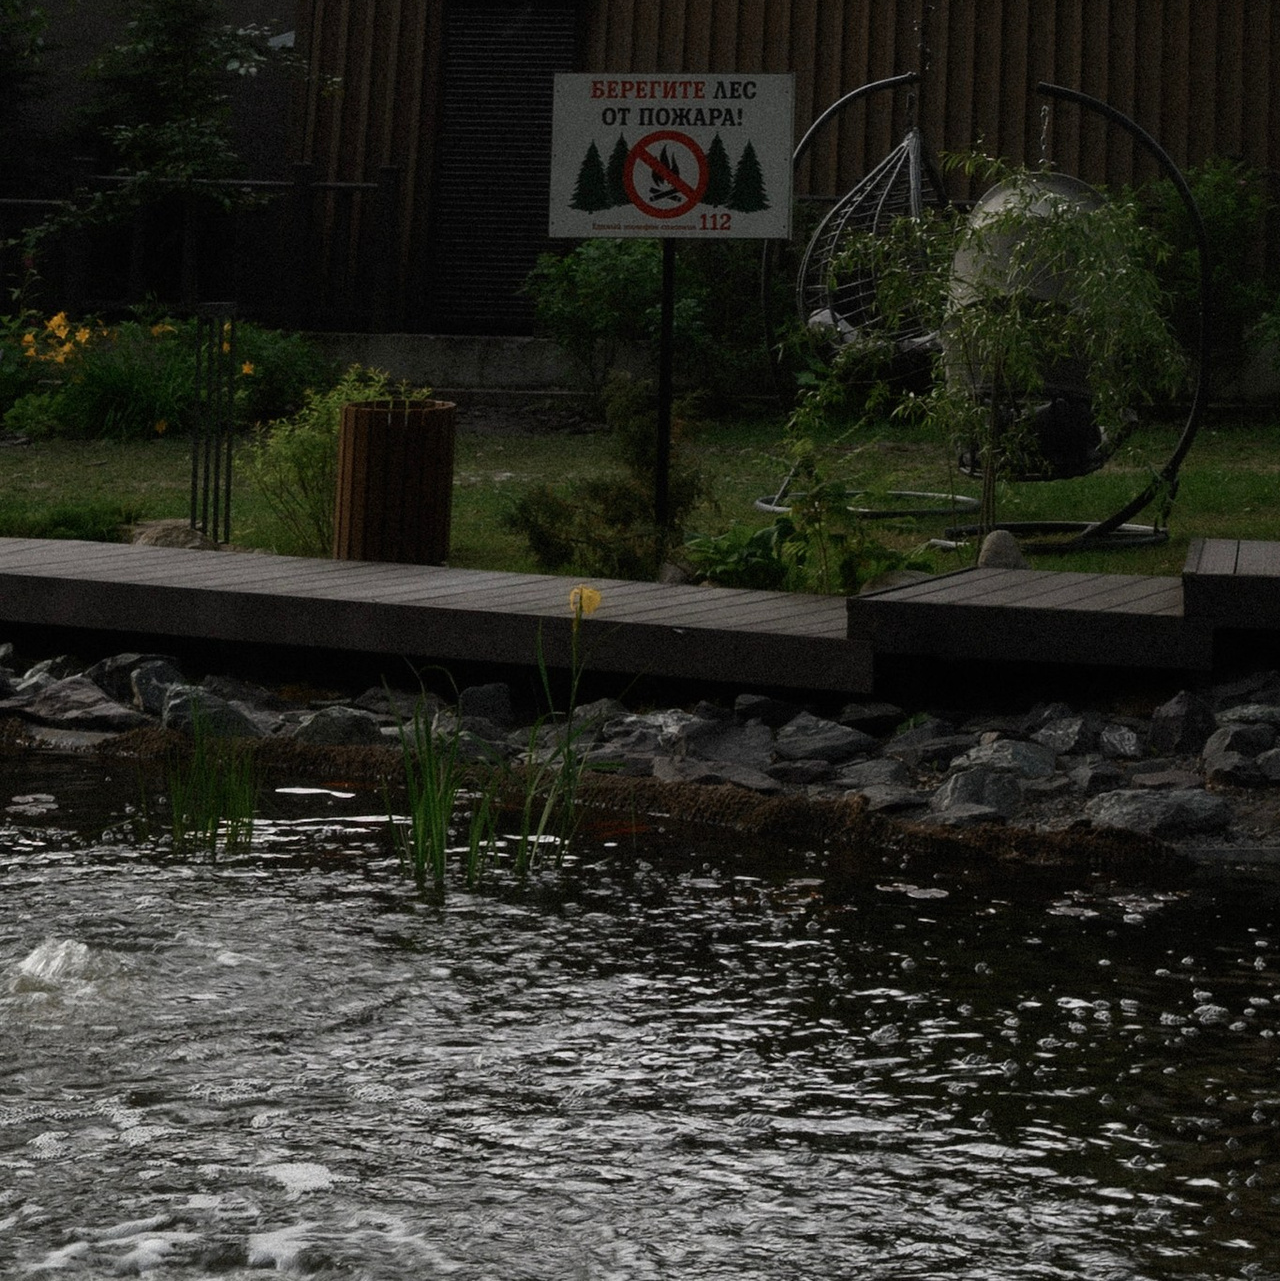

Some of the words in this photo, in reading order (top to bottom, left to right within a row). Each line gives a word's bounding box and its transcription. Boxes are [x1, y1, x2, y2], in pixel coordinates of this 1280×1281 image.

[591, 81, 706, 99] БЕРЕГИТЕ
[713, 81, 757, 100] ЛЕС
[602, 108, 630, 126] ОТ
[639, 108, 743, 127] ПОЖАРА!
[699, 213, 732, 231] 112
